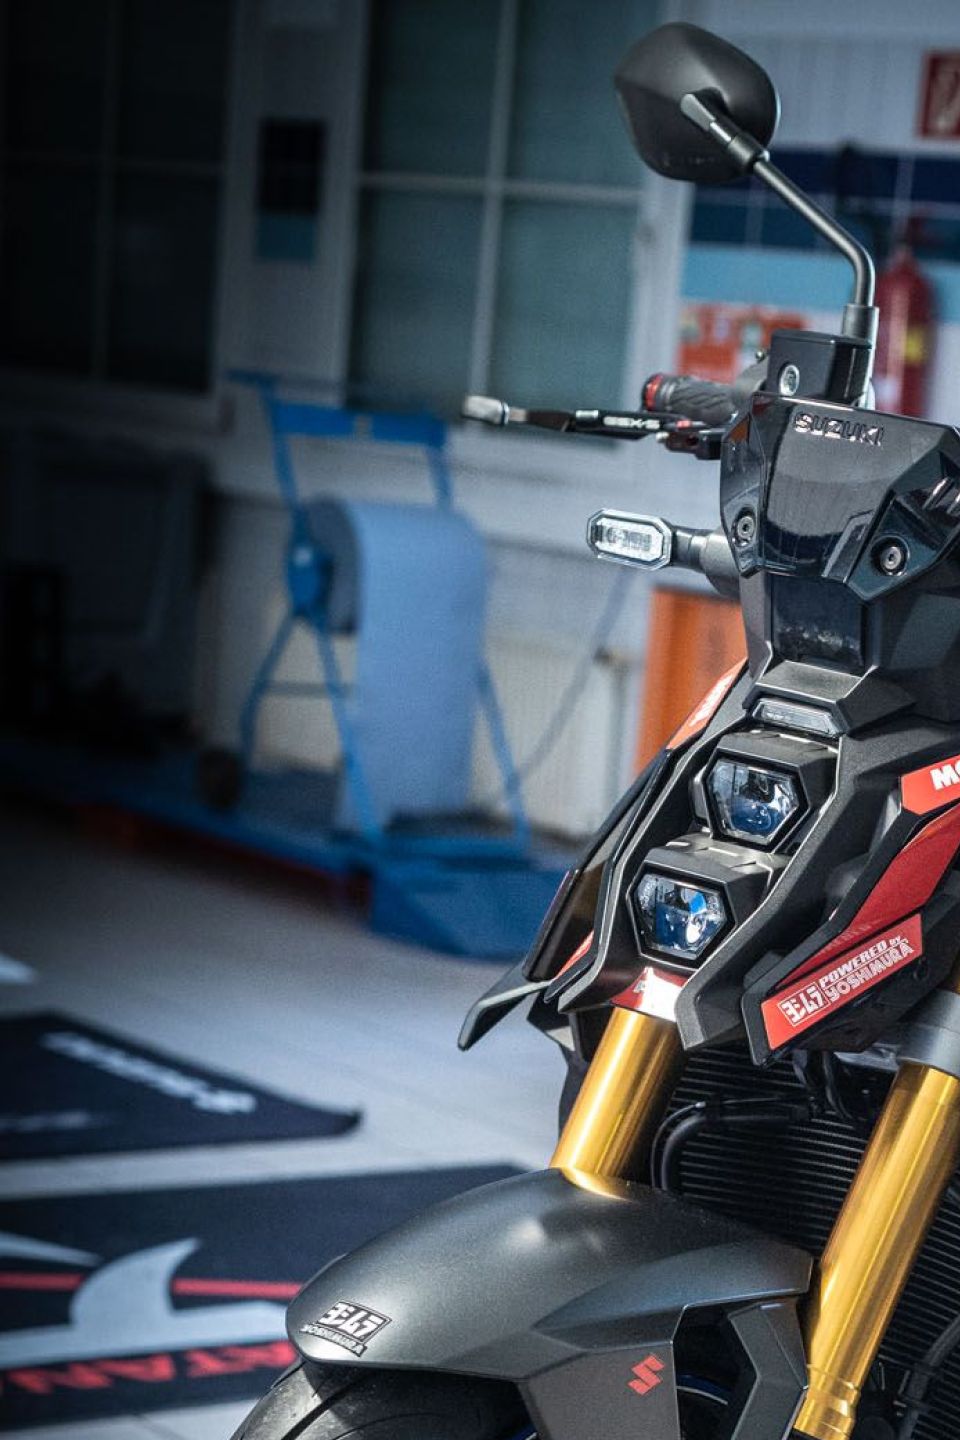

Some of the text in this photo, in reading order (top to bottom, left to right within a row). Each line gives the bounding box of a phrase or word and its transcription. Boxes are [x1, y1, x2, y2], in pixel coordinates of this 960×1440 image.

[795, 413, 884, 446] SUZUKI
[819, 940, 888, 988] POWERED
[824, 943, 915, 1003] YOSHIMURA
